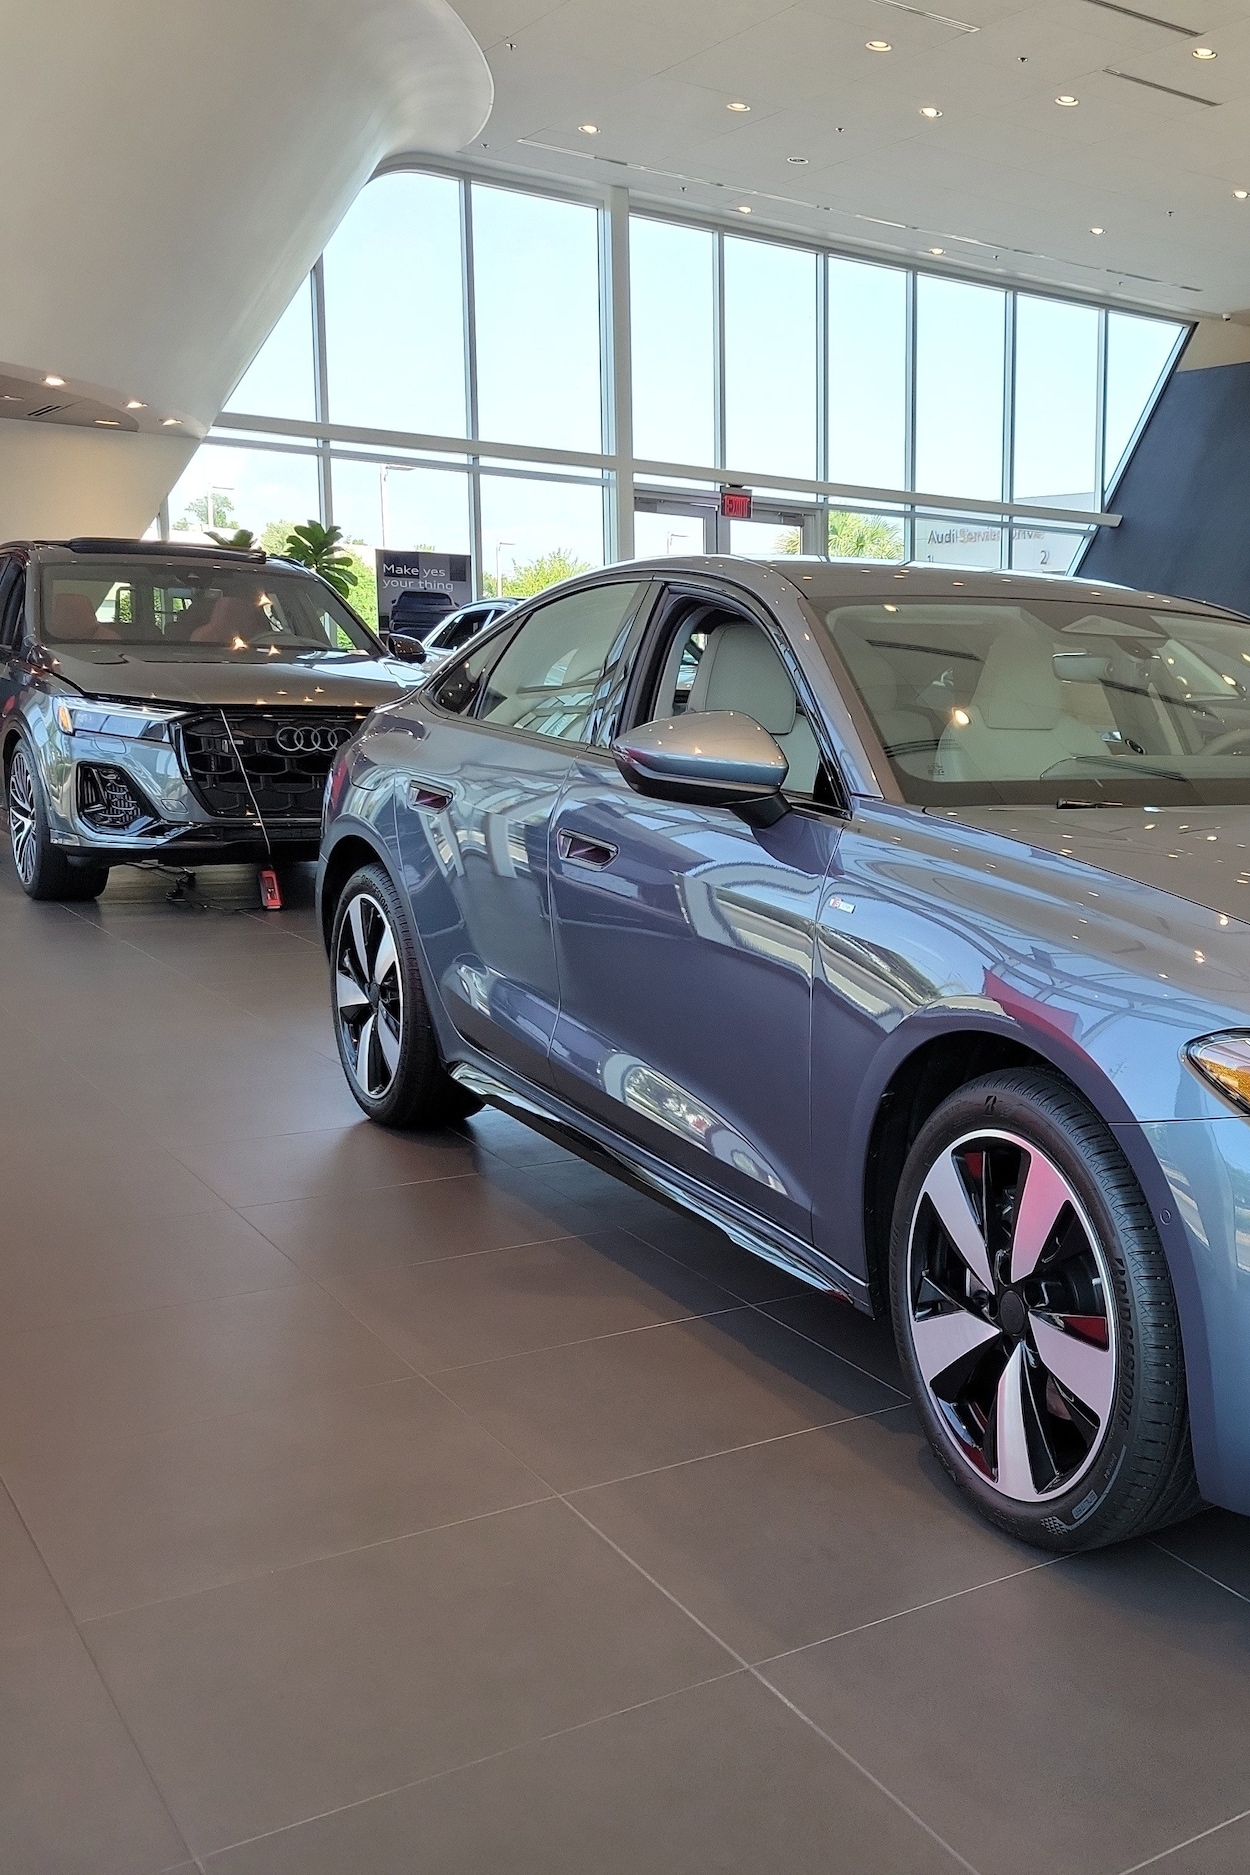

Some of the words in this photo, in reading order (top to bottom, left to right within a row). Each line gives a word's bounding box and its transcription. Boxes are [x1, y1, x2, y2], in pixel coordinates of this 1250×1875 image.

[725, 496, 749, 517] EXIT
[928, 529, 957, 545] Audi
[1040, 550, 1048, 565] 2
[383, 563, 419, 576] Make
[423, 567, 446, 578] yes
[382, 579, 414, 589] your
[418, 580, 454, 593] thing
[1113, 1257, 1136, 1431] BRIDGESTONE
